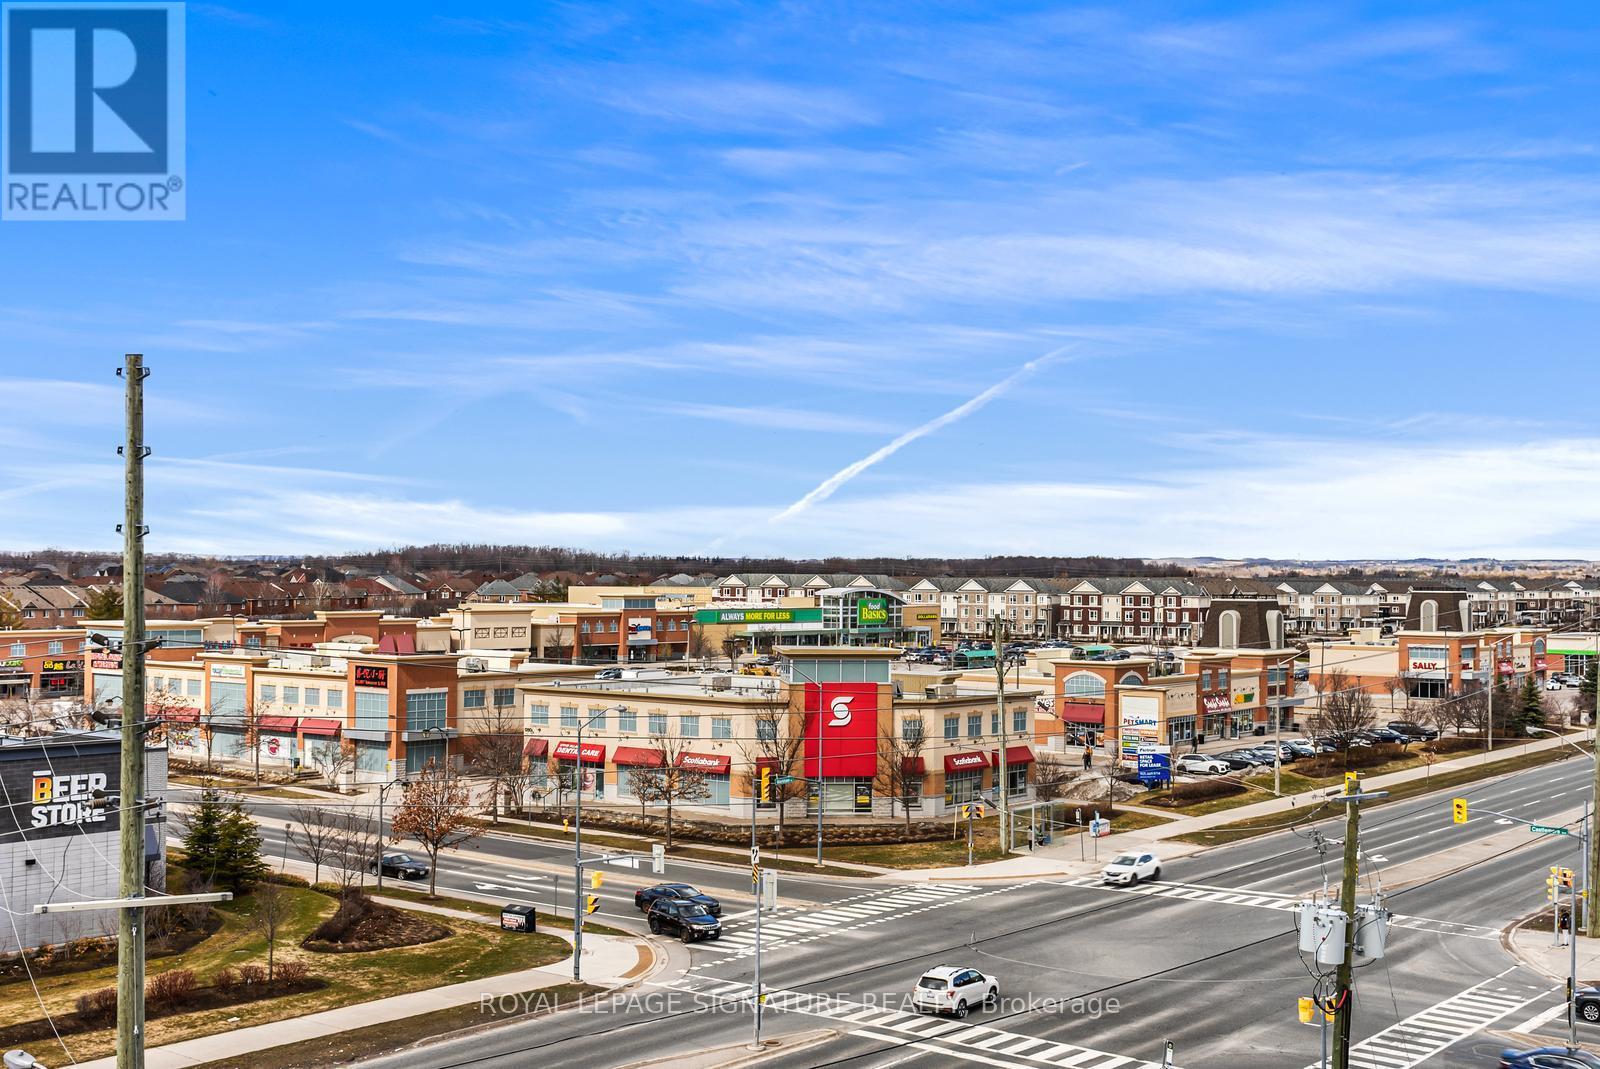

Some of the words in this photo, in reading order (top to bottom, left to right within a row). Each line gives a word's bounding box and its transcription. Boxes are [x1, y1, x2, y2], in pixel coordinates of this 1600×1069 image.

[868, 602, 880, 610] food
[721, 612, 744, 621] ALWAYS
[745, 612, 761, 620] MORE
[763, 612, 775, 620] FOR
[776, 612, 790, 620] LESS
[862, 607, 887, 619] Basics
[1123, 718, 1157, 726] PETSMART
[556, 747, 581, 755] DENTA
[682, 755, 720, 766] Scotiabank
[32, 773, 107, 804] BEER
[31, 800, 106, 827] STORE
